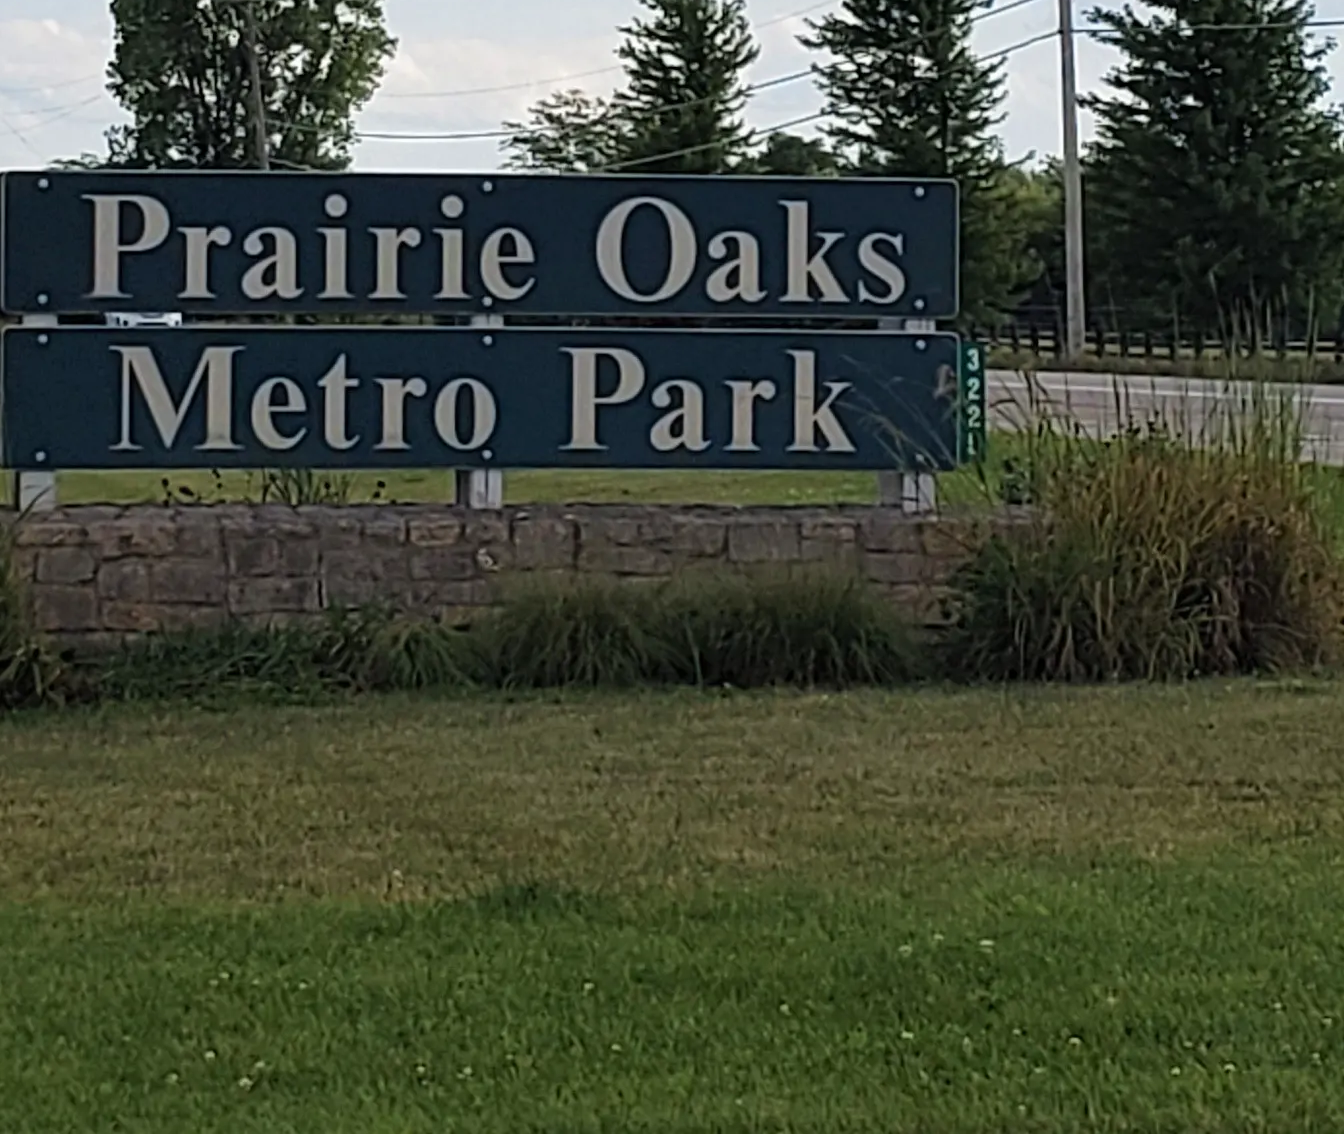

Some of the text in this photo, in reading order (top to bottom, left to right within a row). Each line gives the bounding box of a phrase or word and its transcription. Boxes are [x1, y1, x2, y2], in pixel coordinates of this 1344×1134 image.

[80, 193, 906, 305] Prairie Oaks
[107, 345, 857, 453] Metro Park
[965, 347, 981, 456] 3221
